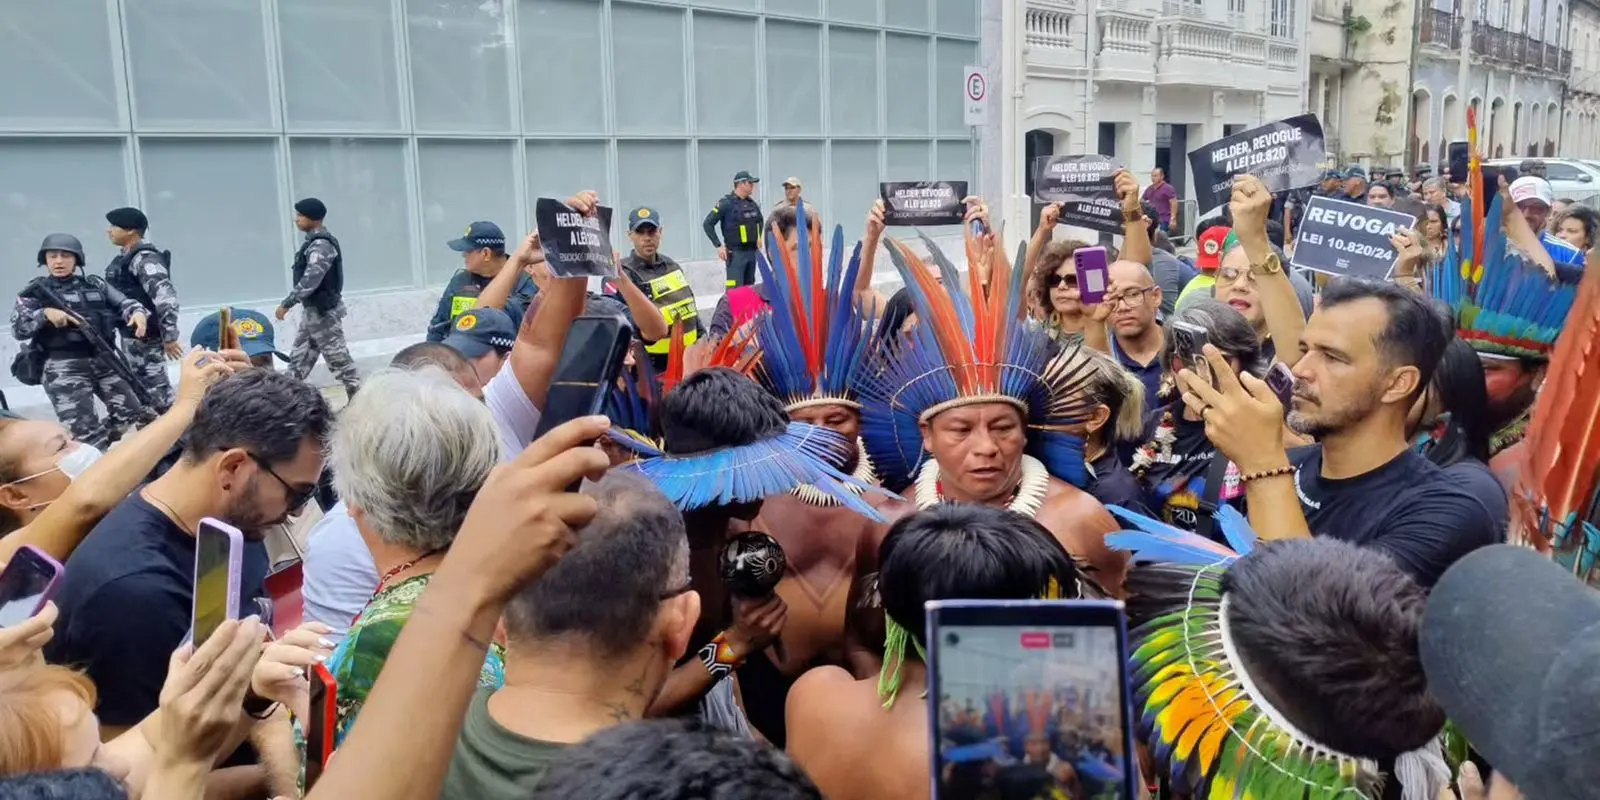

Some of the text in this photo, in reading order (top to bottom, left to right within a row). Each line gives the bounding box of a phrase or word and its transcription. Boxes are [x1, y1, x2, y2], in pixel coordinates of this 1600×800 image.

[973, 79, 980, 95] E
[1252, 127, 1302, 150] REVOGUE
[1080, 162, 1111, 172] REVOGUE
[1226, 160, 1232, 173] A
[1233, 154, 1249, 170] LEI
[1250, 146, 1286, 166] 10.820
[1061, 173, 1100, 182] A LEI 10.820
[570, 231, 577, 246] A
[1302, 232, 1393, 260] LEI 10.820/24
